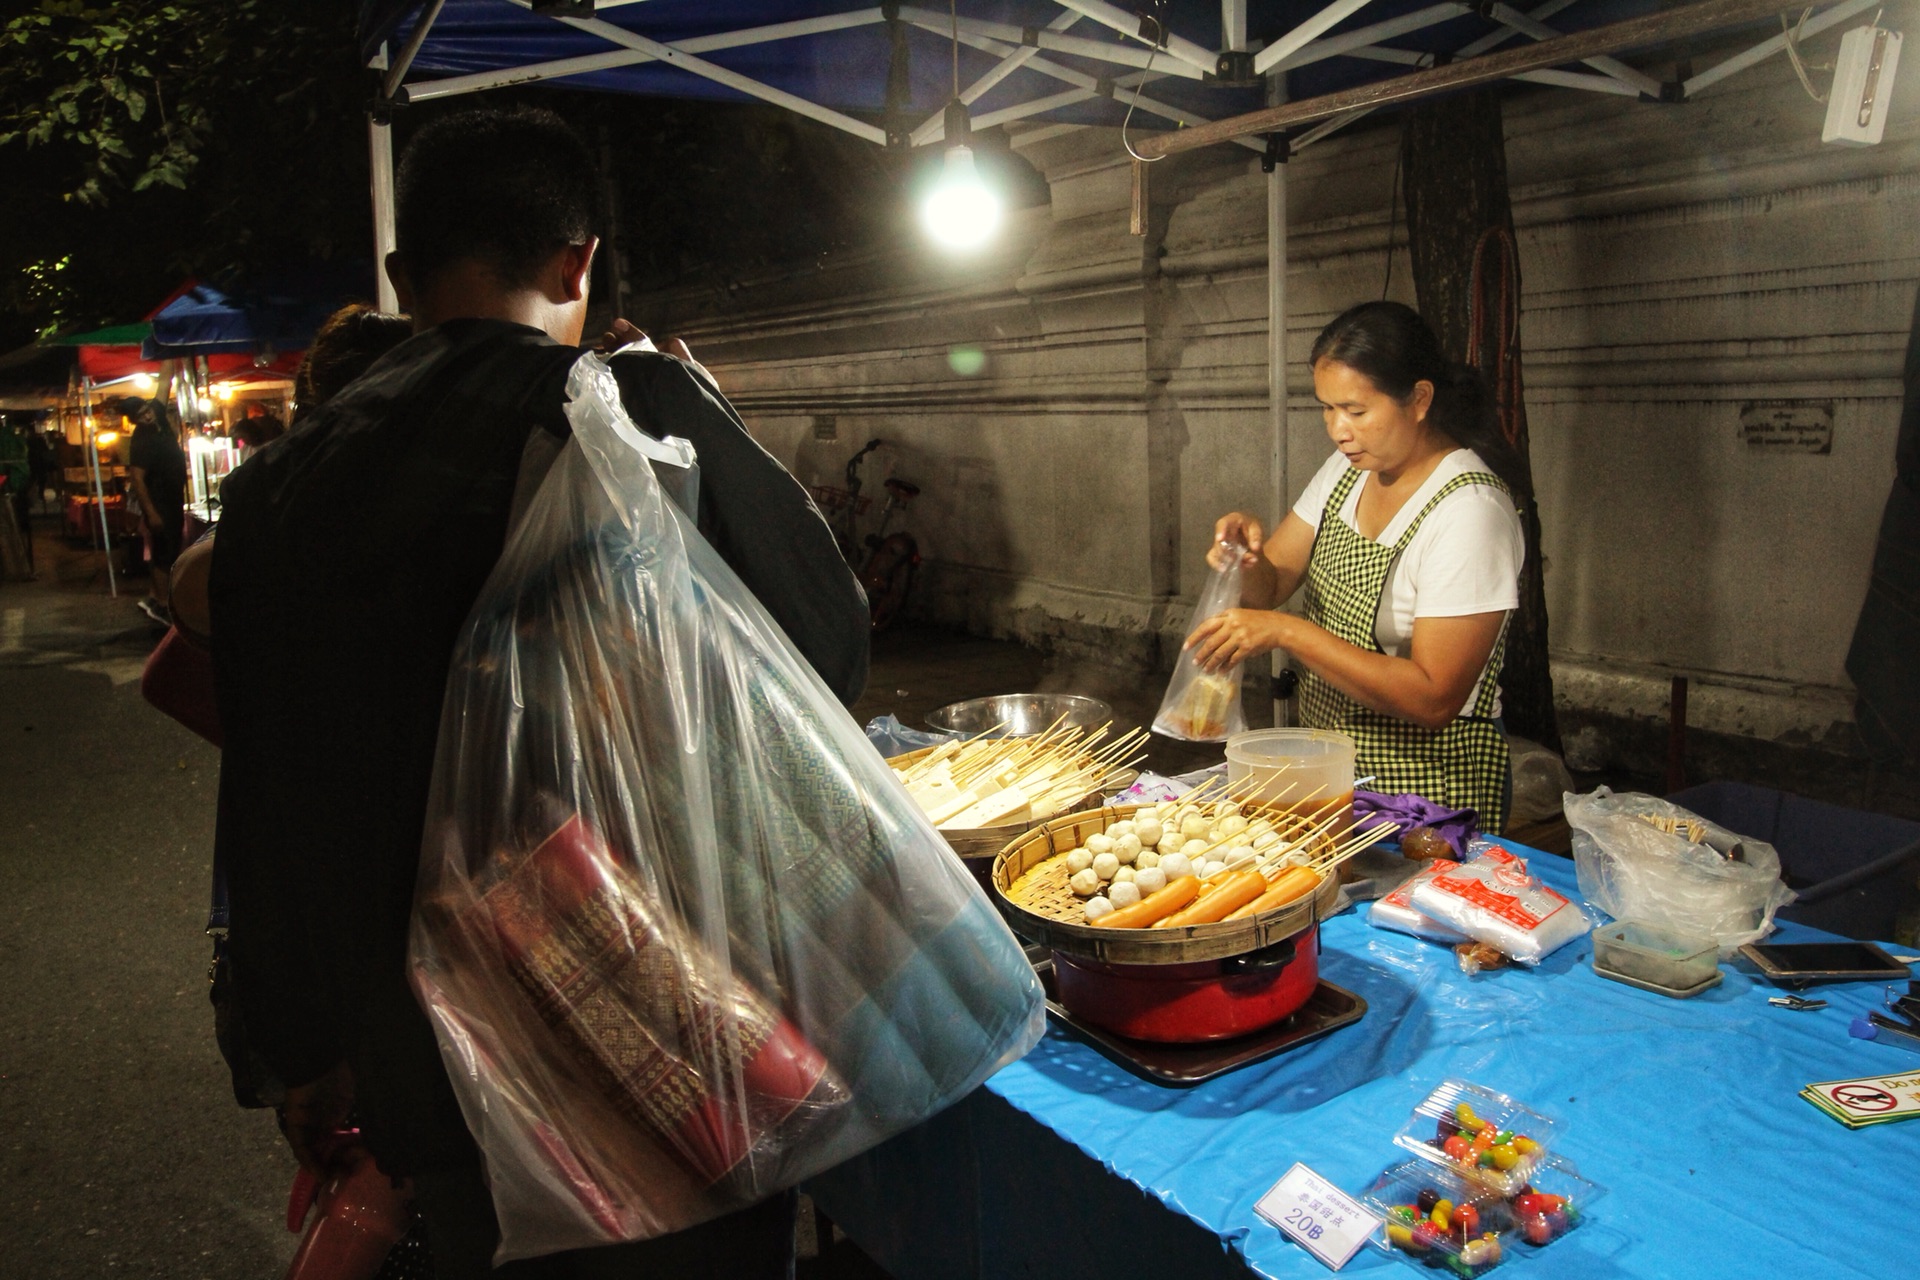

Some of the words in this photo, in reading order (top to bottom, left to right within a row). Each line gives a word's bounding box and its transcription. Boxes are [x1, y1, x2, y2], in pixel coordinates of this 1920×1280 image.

[1879, 1079, 1908, 1089] Do
[1297, 1192, 1344, 1228] 泰国甜点
[1304, 1177, 1324, 1194] Thai
[1326, 1193, 1360, 1219] dessert
